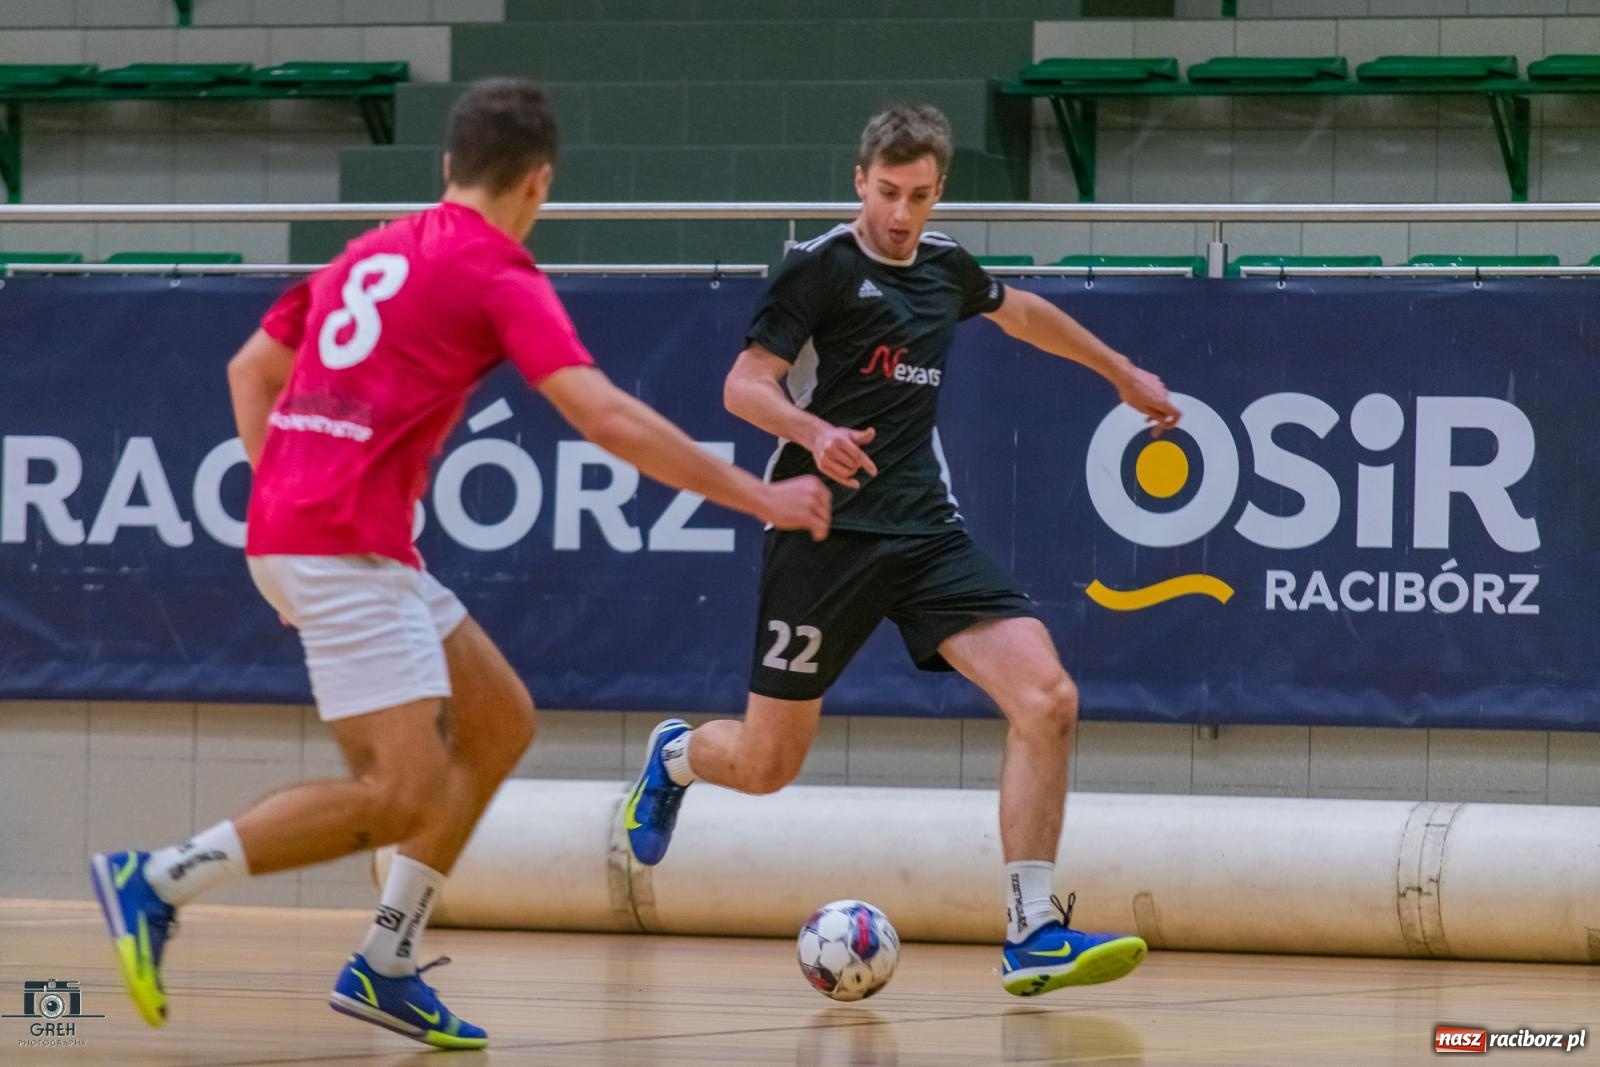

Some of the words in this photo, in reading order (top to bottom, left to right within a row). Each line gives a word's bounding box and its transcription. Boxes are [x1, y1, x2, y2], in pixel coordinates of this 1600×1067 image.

[318, 253, 410, 370] 8
[2, 397, 736, 553] RACÓRZ
[1265, 558, 1541, 614] RACIBÓRZ
[762, 619, 823, 674] 22
